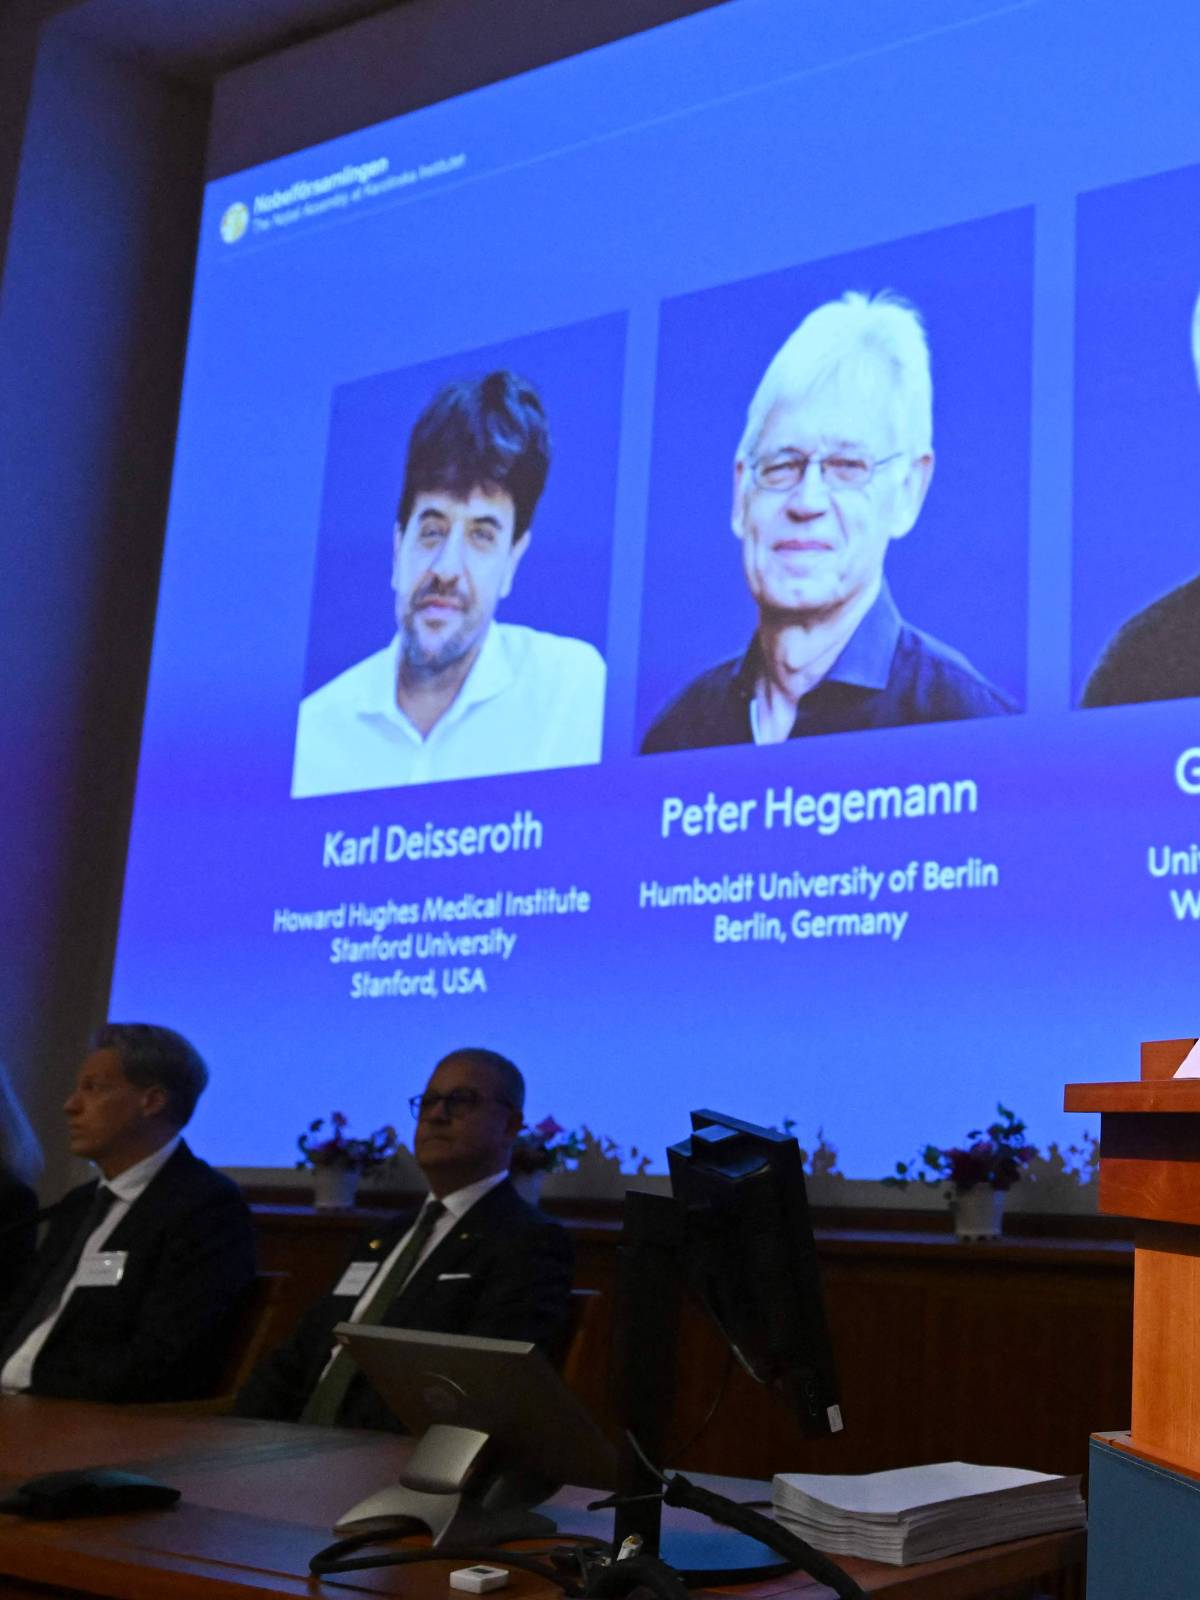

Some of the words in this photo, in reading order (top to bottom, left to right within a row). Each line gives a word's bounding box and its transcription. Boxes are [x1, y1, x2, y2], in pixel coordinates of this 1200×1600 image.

[661, 792, 757, 839] Peter
[764, 779, 978, 836] Hegemann
[322, 826, 380, 868] Karl
[385, 810, 543, 863] Deisseroth
[639, 873, 753, 909] Humboldt
[758, 865, 885, 902] University
[888, 860, 920, 893] of
[922, 857, 1000, 892] Berlin
[273, 903, 346, 933] Howard
[348, 899, 420, 932] Hughes
[421, 892, 501, 925] Medical
[504, 884, 592, 917] Institute
[713, 911, 787, 943] Berlin,
[791, 908, 909, 941] Germany
[329, 932, 412, 964] Stanford
[415, 926, 518, 960] University
[350, 968, 438, 999] Stanford,
[442, 966, 488, 994] USA
